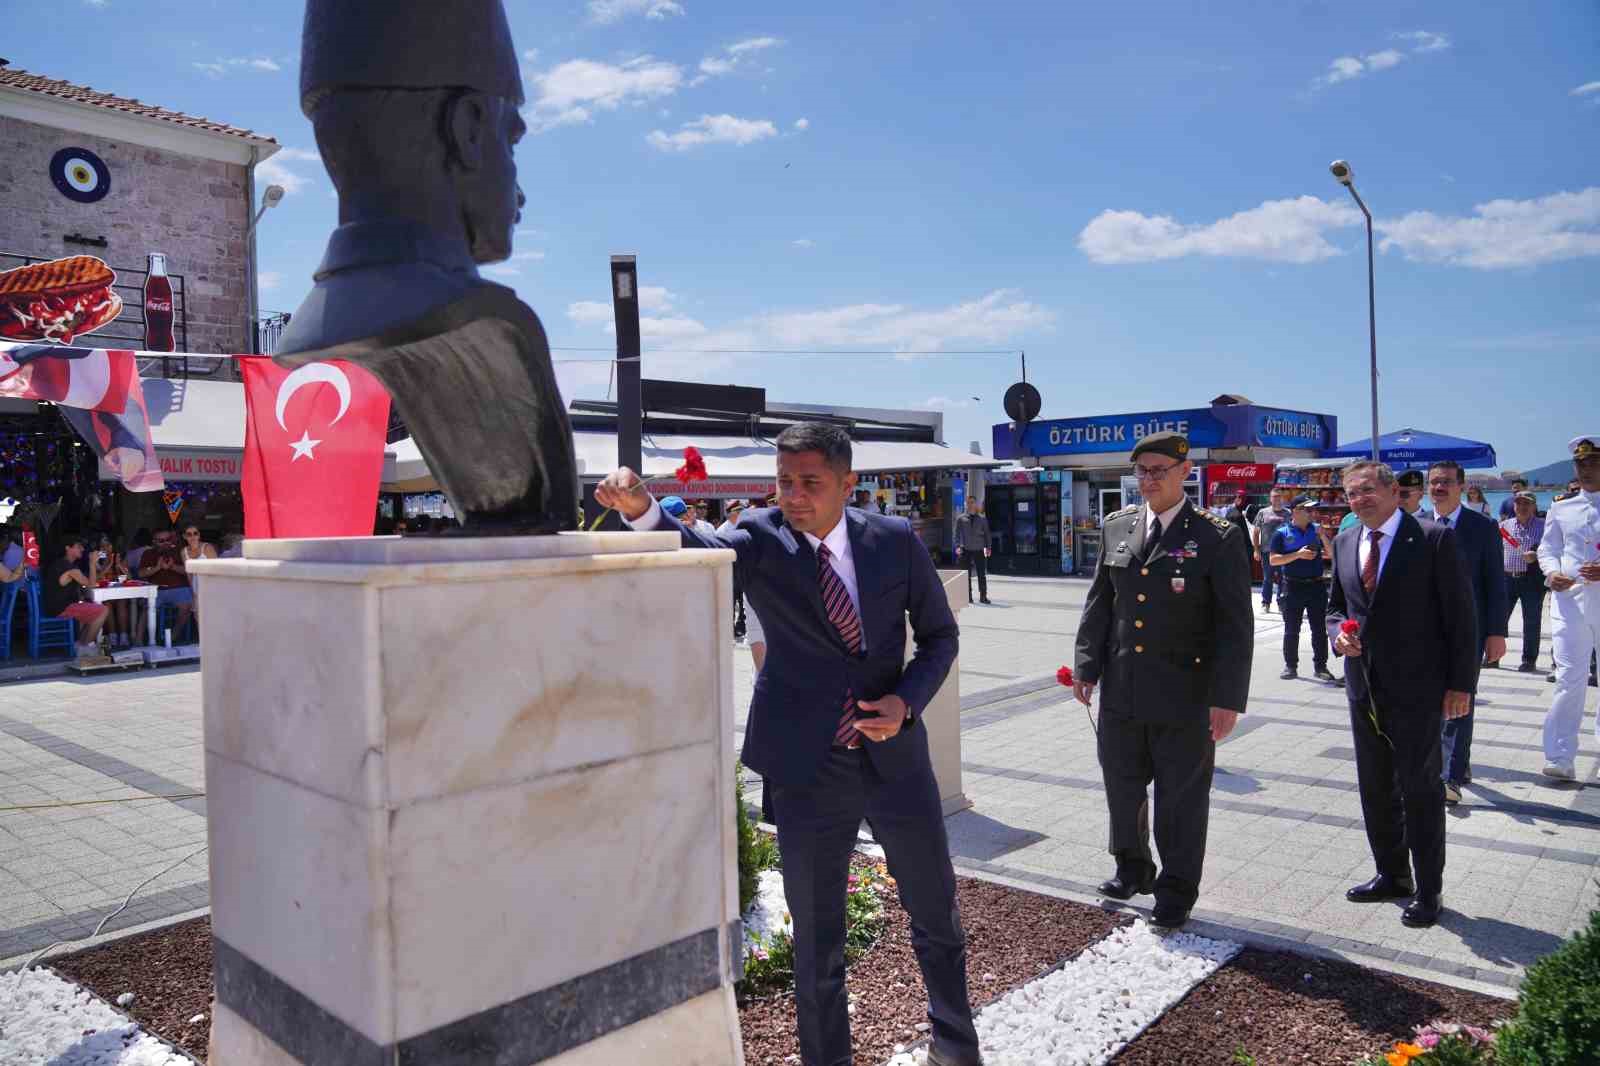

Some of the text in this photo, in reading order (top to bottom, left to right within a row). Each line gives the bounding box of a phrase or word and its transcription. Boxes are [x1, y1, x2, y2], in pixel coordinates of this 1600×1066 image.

[1050, 424, 1125, 446] ÖZTÜRK
[1266, 416, 1320, 440] ÖZTÜRK BÜFE
[196, 459, 236, 474] TOSTU
